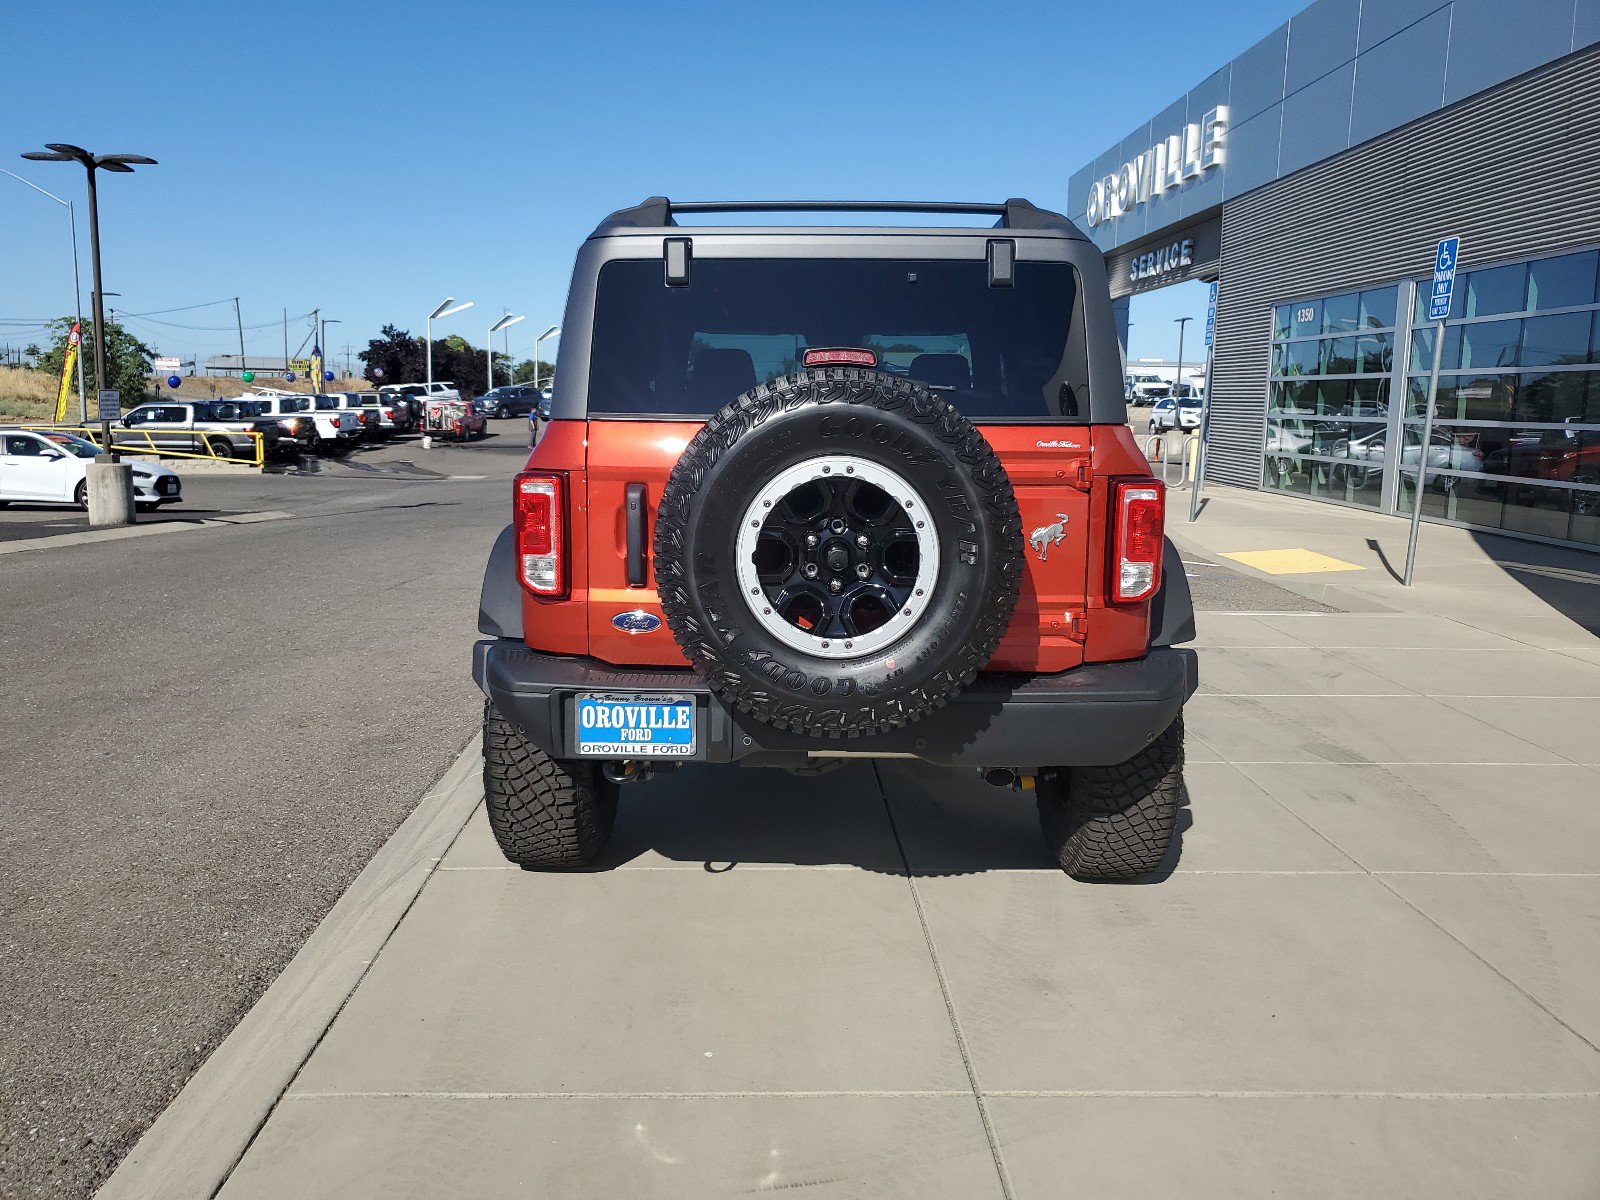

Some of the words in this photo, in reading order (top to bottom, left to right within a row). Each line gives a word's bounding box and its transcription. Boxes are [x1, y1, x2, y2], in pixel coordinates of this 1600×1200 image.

[1087, 105, 1229, 227] OROVILLE
[1130, 239, 1192, 281] SERVICE
[1297, 307, 1314, 323] 1350
[623, 616, 650, 628] Ford
[604, 694, 631, 702] Benny
[582, 705, 690, 729] OROVILLE
[620, 728, 652, 740] FORD
[581, 744, 648, 753] OROVILLE
[652, 745, 689, 754] FORD
